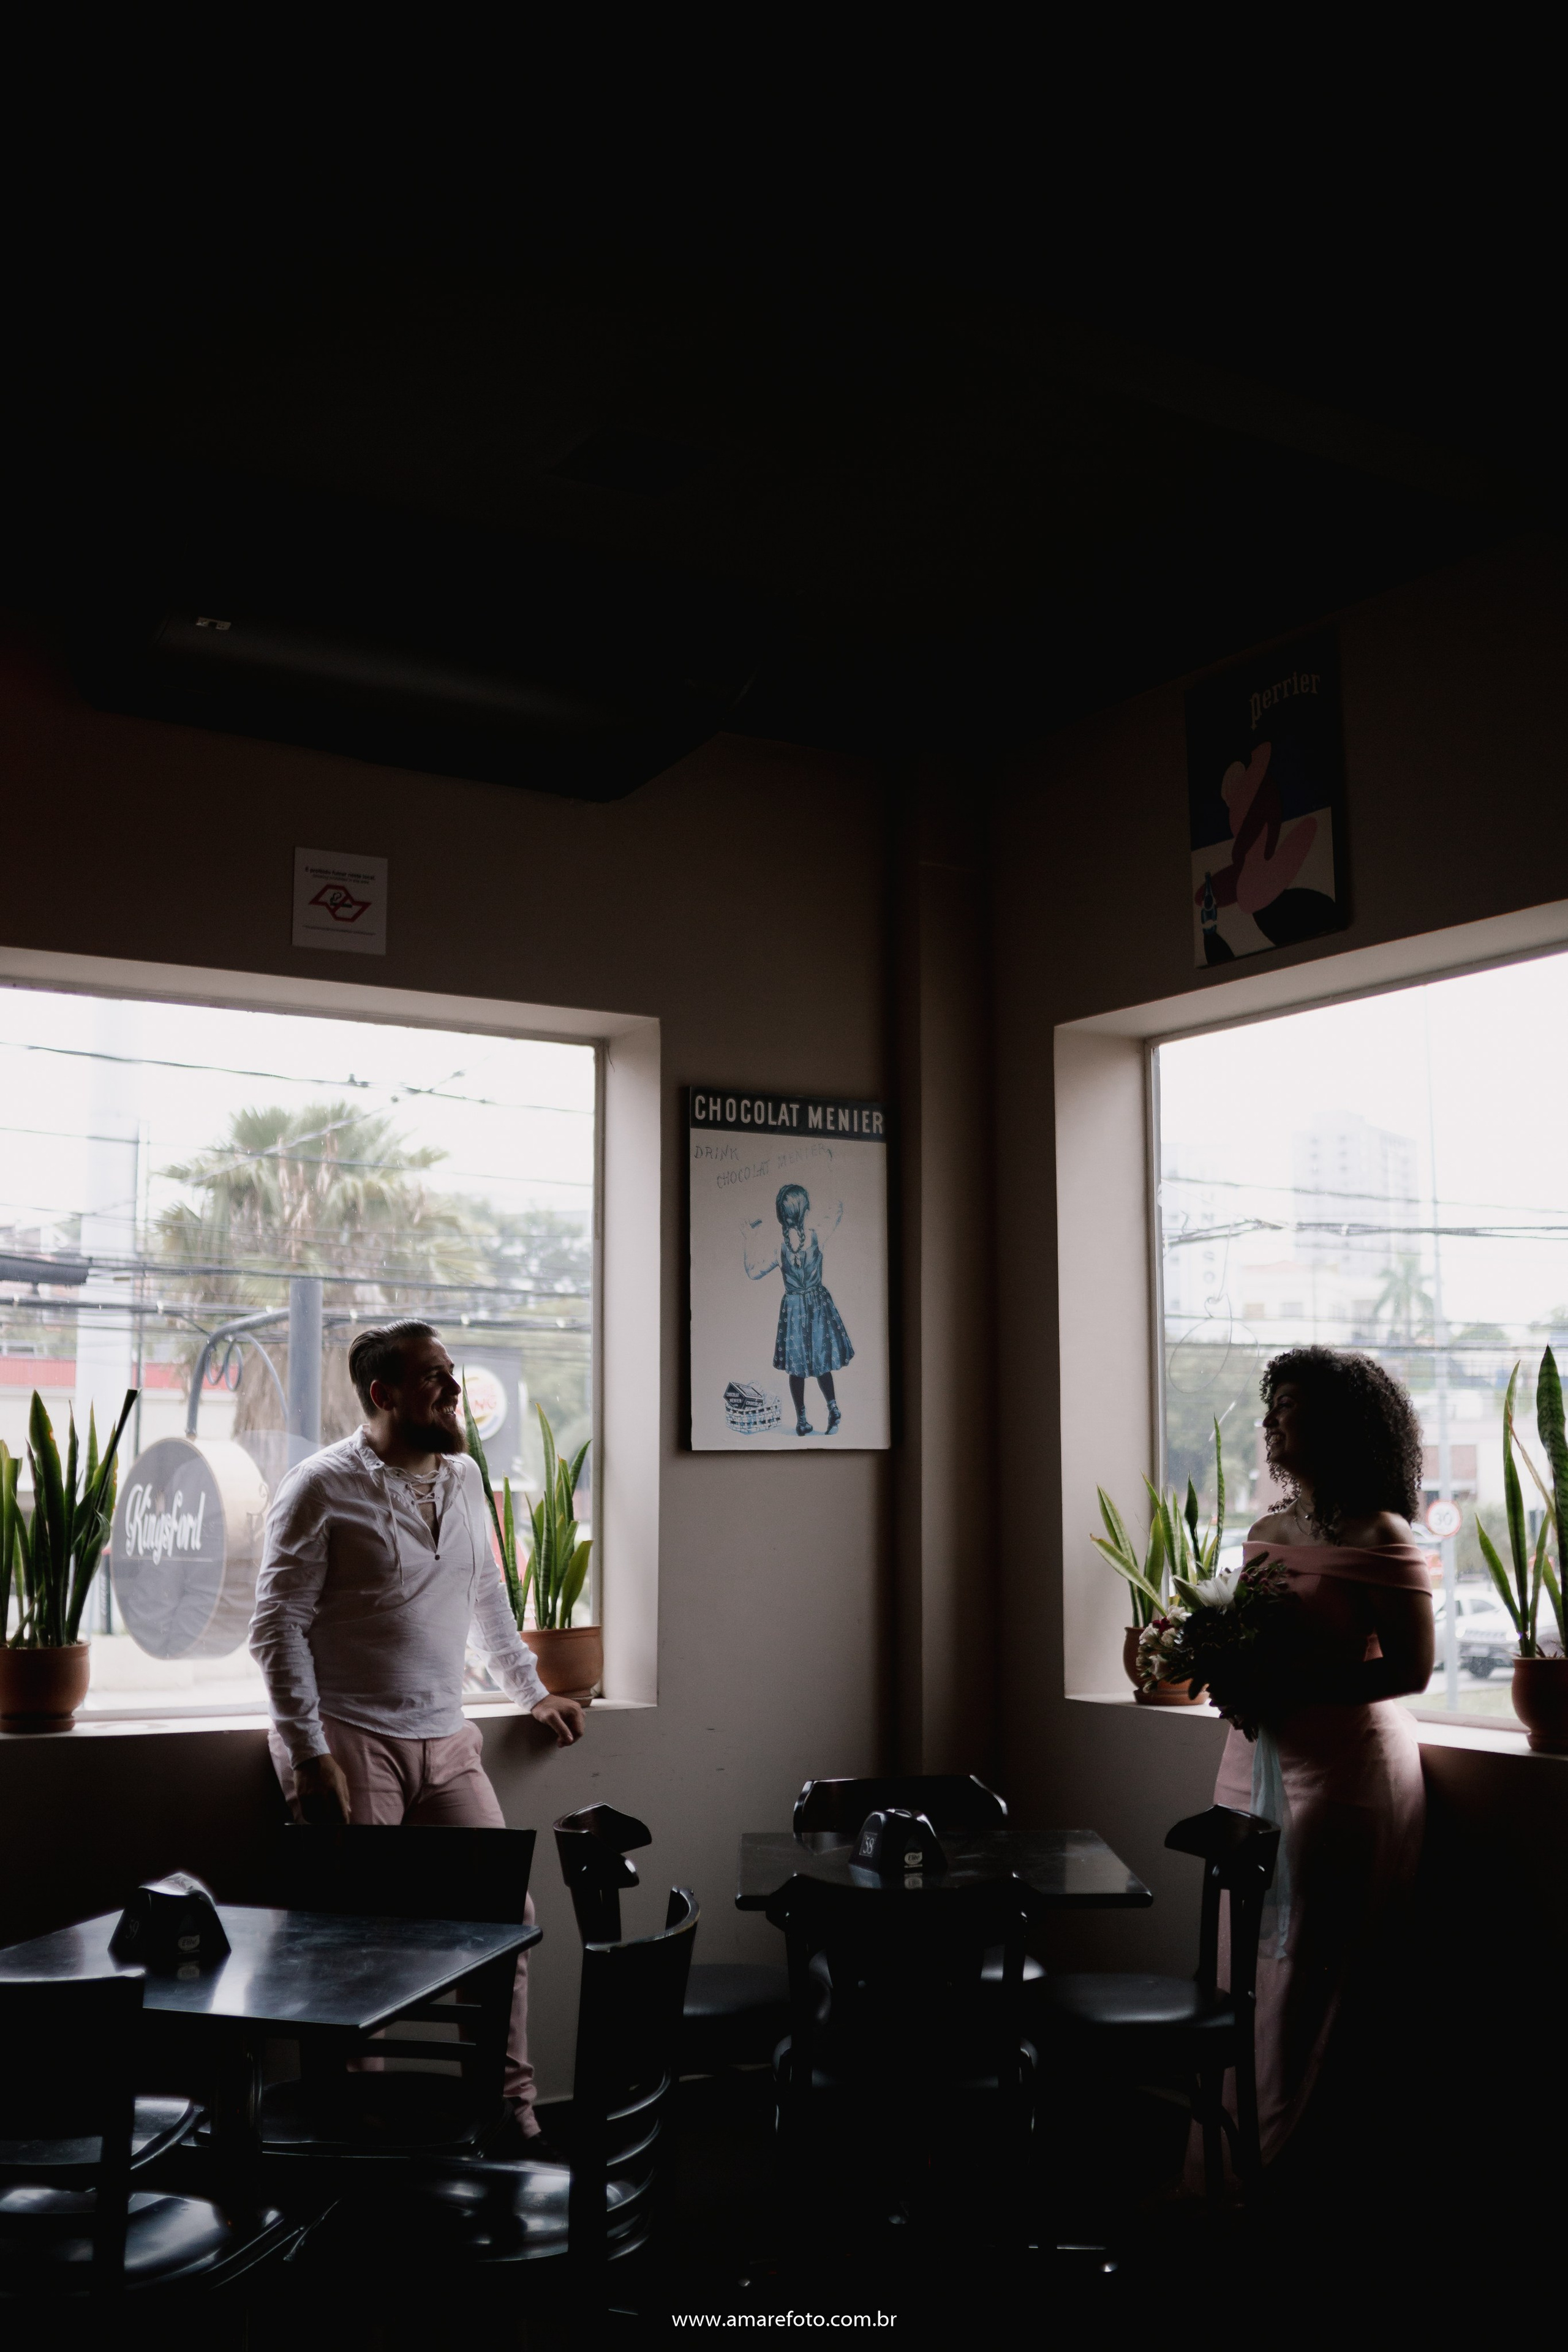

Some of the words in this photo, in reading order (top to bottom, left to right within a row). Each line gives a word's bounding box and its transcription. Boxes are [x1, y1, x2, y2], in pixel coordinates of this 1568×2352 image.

[1249, 671, 1321, 732] perrier
[695, 1095, 800, 1128] CHOCOLAT
[808, 1105, 883, 1134] MENIER
[694, 1144, 739, 1161] DRINK
[717, 1159, 771, 1189] CHOCOLAT
[125, 1483, 205, 1566] Kingsford
[1435, 1512, 1453, 1526] 30
[862, 1836, 875, 1855] 58
